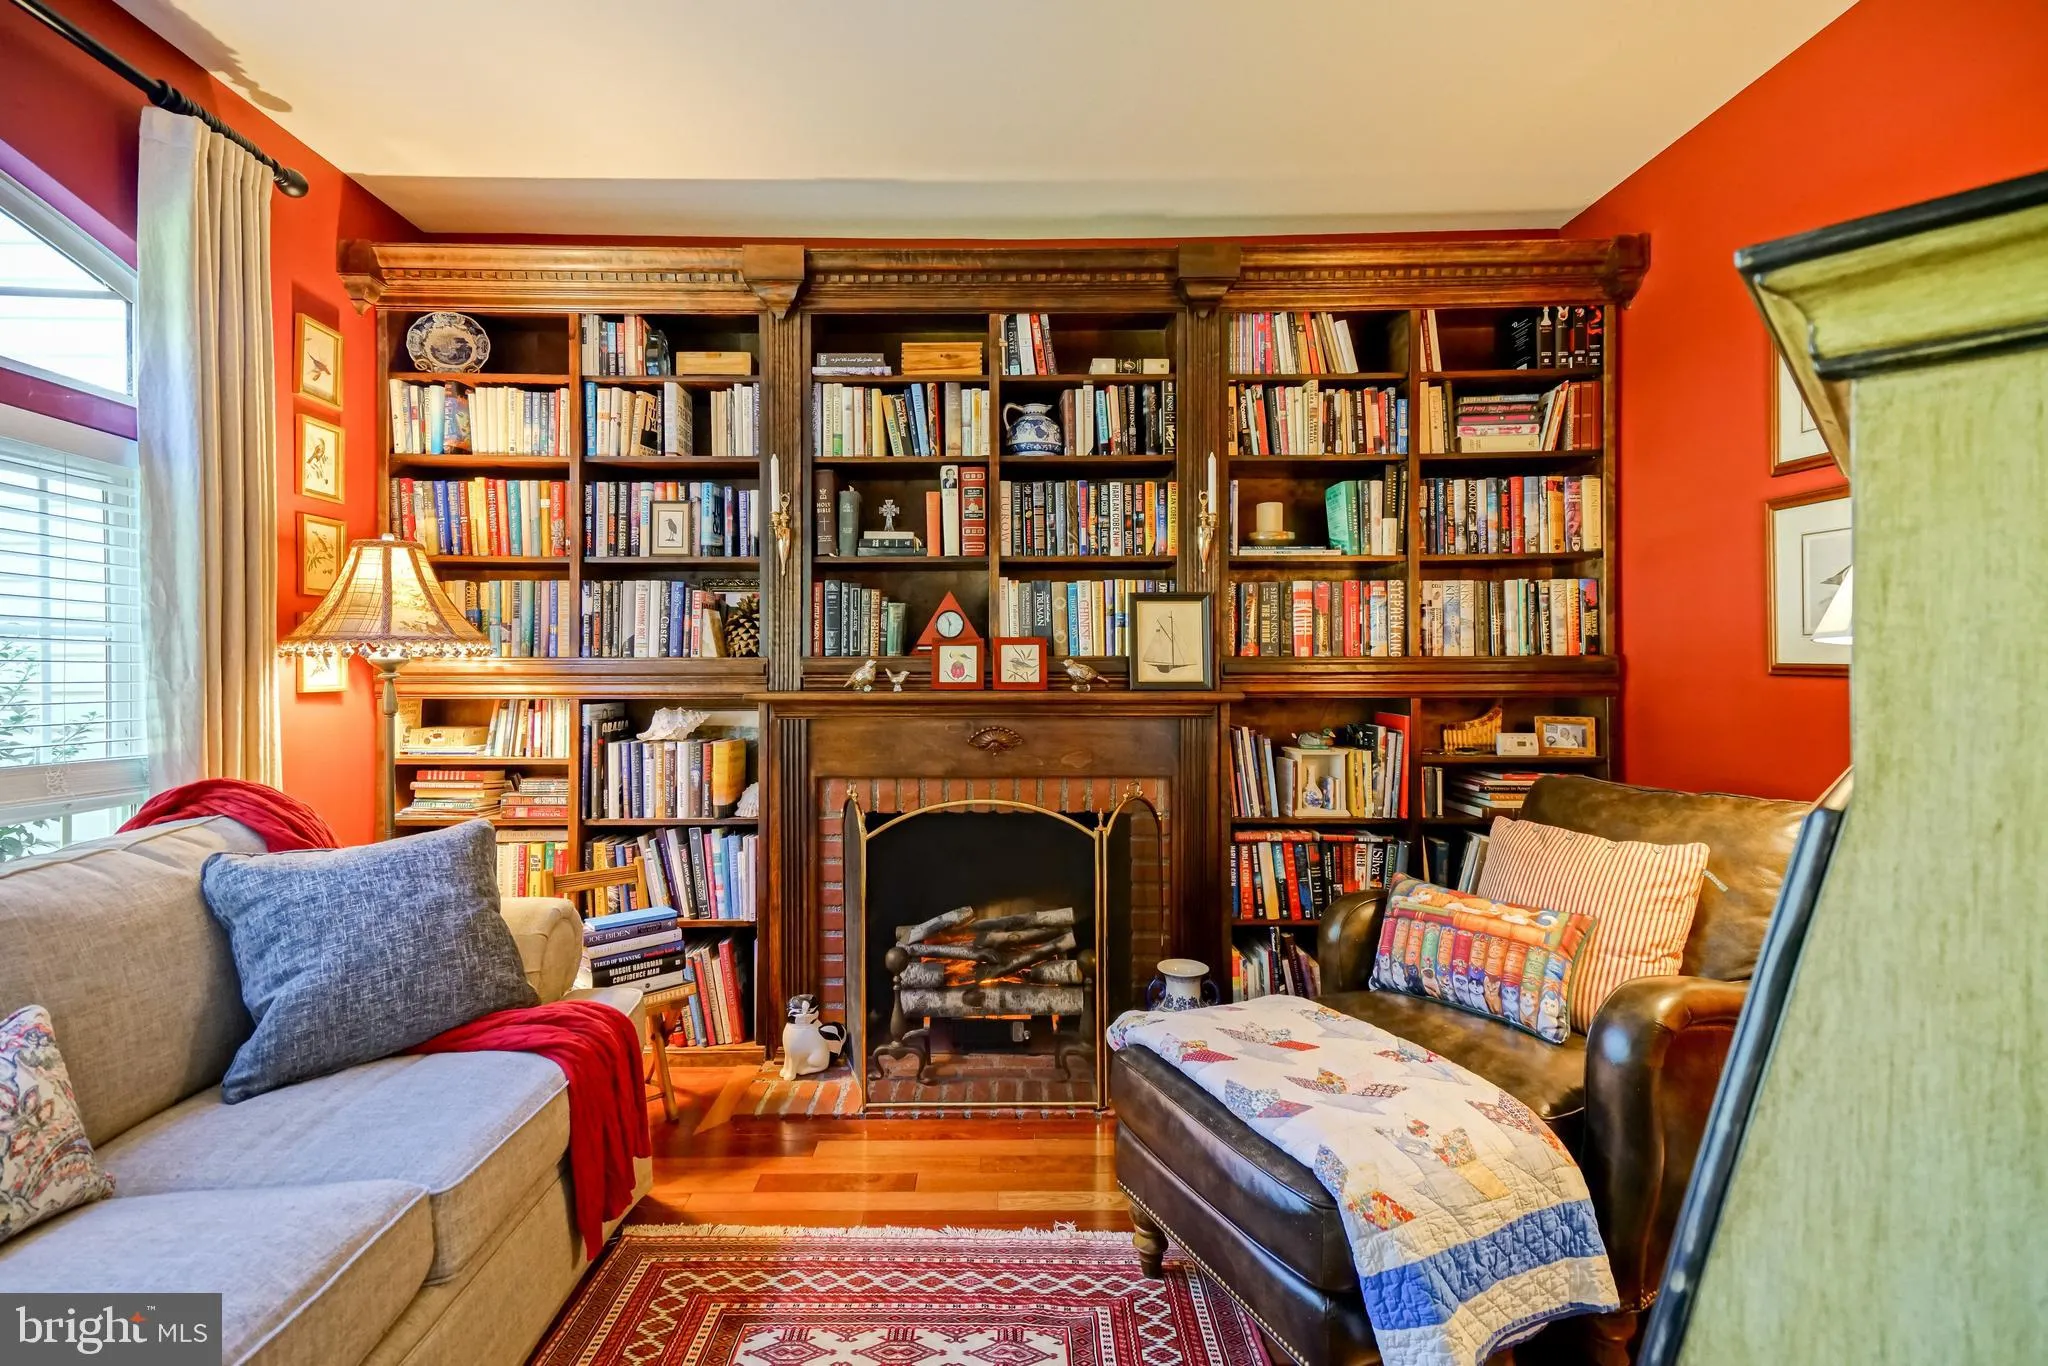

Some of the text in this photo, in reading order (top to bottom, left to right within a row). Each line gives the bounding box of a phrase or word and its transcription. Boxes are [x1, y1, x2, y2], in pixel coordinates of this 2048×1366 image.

[1112, 485, 1120, 512] HARLAN
[1469, 482, 1477, 513] KOONTZ
[1001, 495, 1010, 543] TUROW
[631, 527, 639, 546] CROSS
[1125, 531, 1133, 549] CAUGHT
[1037, 592, 1045, 626] TRUMAN
[1080, 600, 1090, 641] CHINESE
[1262, 605, 1270, 618] THE
[1294, 605, 1312, 635] KING
[1391, 580, 1401, 657] STEPHEN KING
[661, 616, 669, 646] Caste
[1372, 851, 1384, 875] Silva
[695, 865, 703, 901] ANTHOLOGY
[588, 929, 632, 943] JOE BIDEN
[594, 958, 611, 968] TIRED
[611, 957, 620, 965] OF
[620, 953, 642, 963] WINNING
[610, 959, 663, 977] MAGGIE HABERMAN
[613, 967, 660, 984] CONFIDENCE MAN
